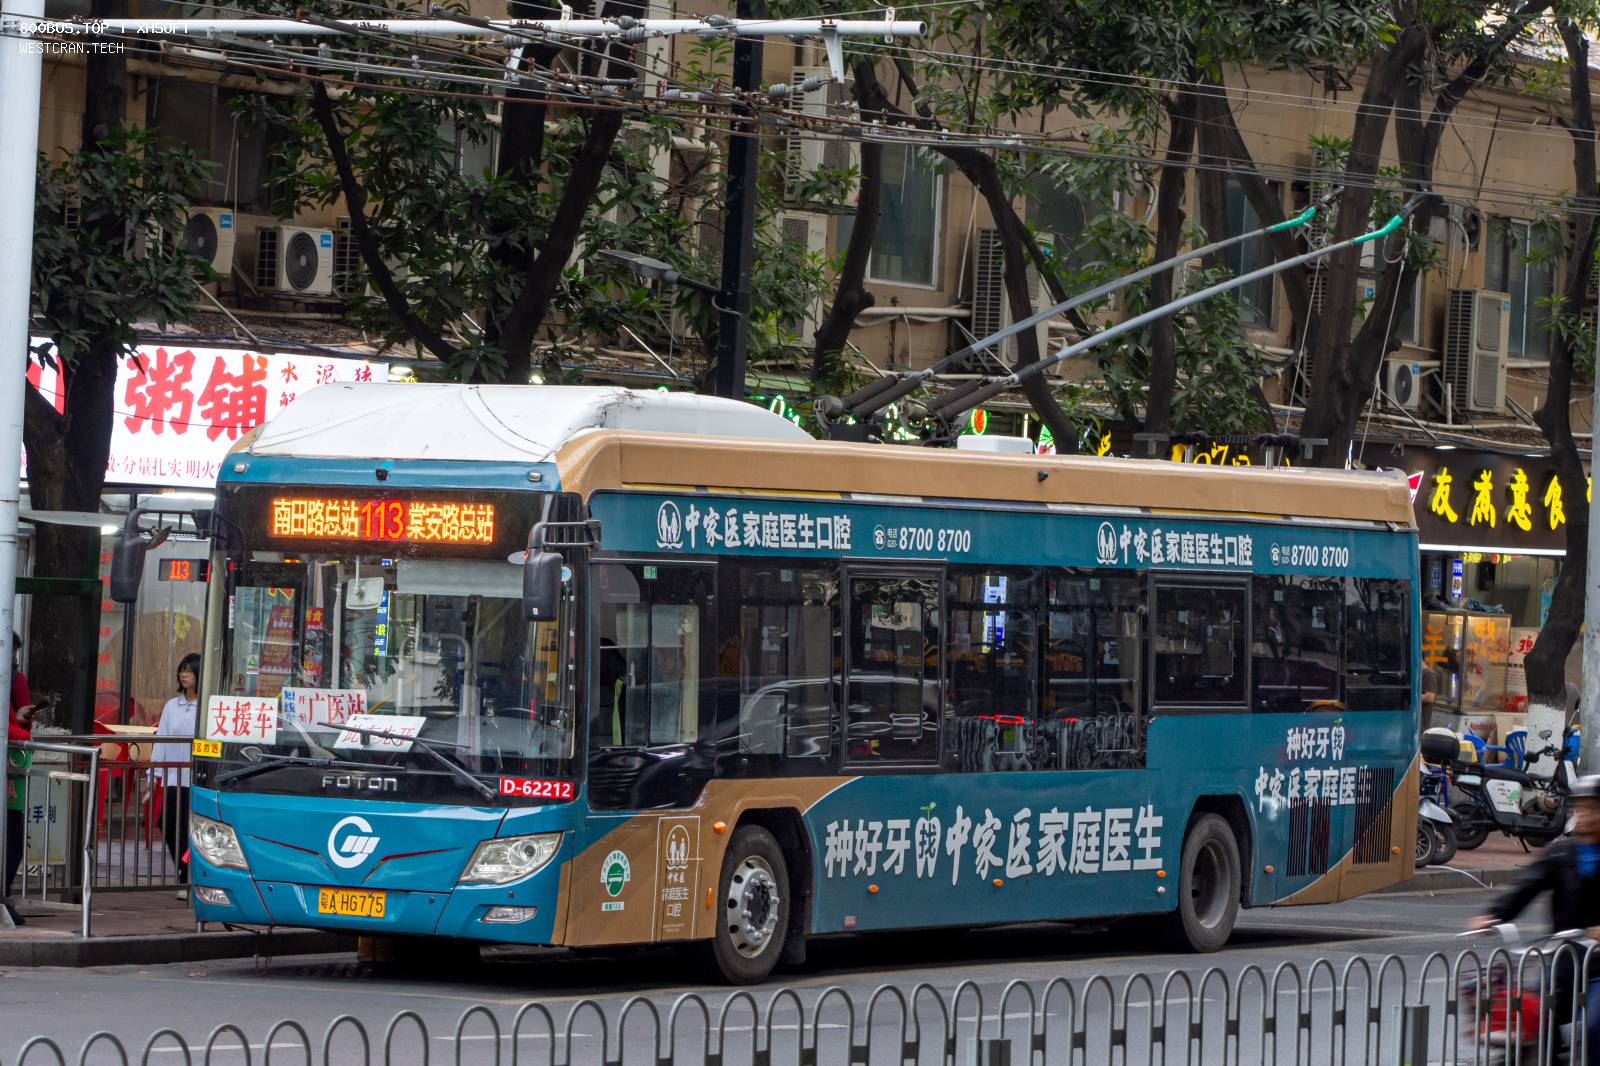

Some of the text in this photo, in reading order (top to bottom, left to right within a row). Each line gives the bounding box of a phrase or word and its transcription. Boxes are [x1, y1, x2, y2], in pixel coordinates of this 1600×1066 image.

[272, 497, 496, 544] 南田路总站 113 棠安路总站
[684, 503, 852, 550] 中家医家庭医生口腔
[899, 526, 934, 551] 8700
[937, 528, 971, 553] 8700
[1119, 524, 1253, 566] 中家医家庭医生口腔
[169, 560, 190, 580] 113
[1291, 544, 1319, 567] 8700
[1321, 546, 1349, 568] 8700
[211, 701, 273, 738] 支援车
[308, 692, 366, 726] 广医站
[322, 776, 398, 791] FOTON
[503, 779, 571, 798] D-62212
